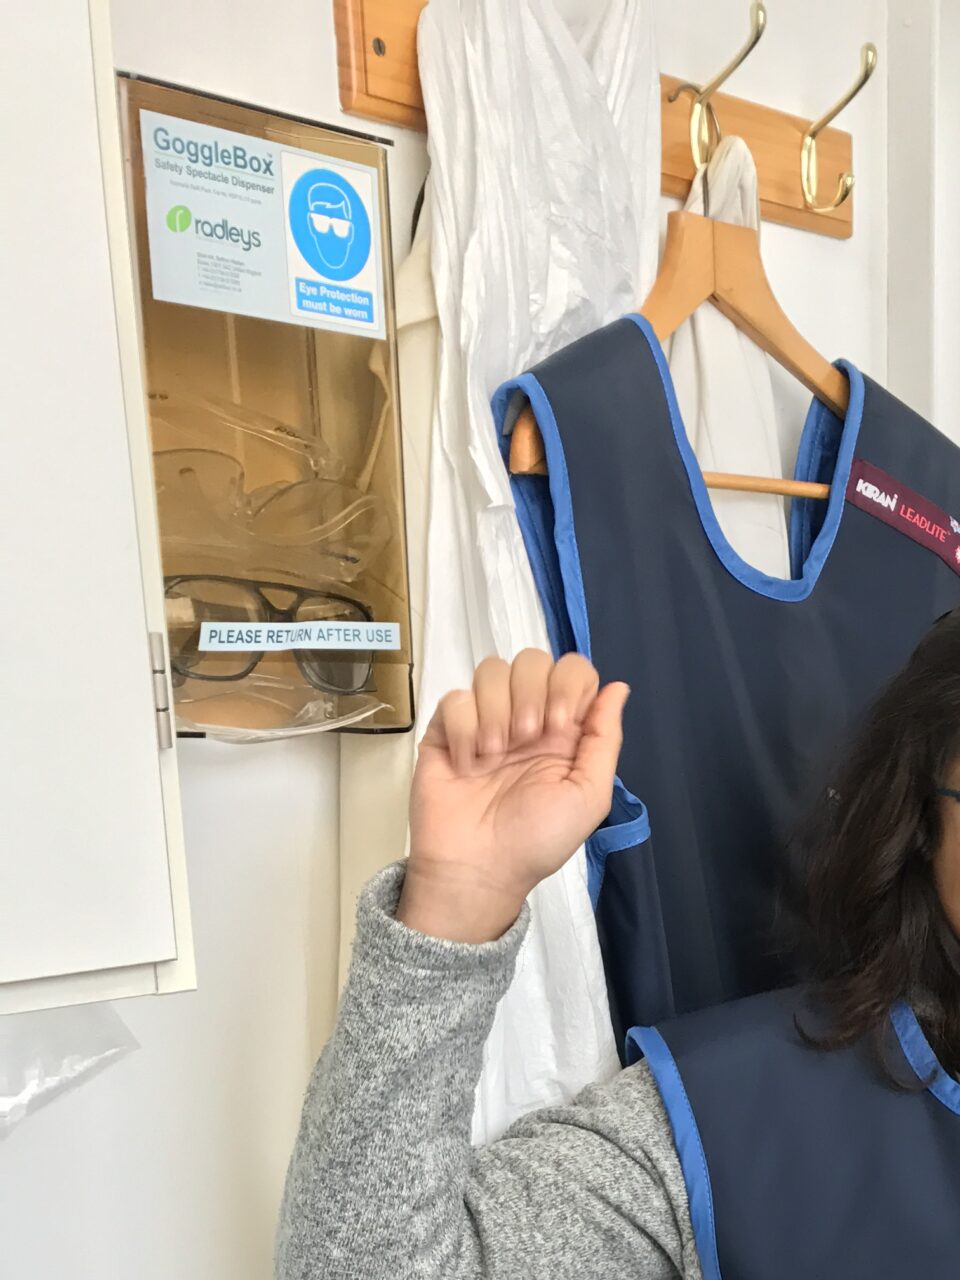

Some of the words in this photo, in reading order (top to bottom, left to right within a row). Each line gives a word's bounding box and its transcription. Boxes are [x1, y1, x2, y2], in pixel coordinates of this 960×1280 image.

[153, 127, 275, 177] GoggleBox
[154, 158, 184, 176] Safety
[186, 165, 230, 184] Spectacle
[231, 175, 275, 195] Dispenser
[194, 217, 262, 252] radleys
[299, 282, 317, 296] Eye
[319, 286, 369, 305] Protection
[302, 299, 327, 312] must
[329, 302, 342, 314] be
[343, 307, 368, 319] worn
[900, 504, 946, 543] LEADLITE
[208, 629, 262, 644] PLEASE
[266, 628, 312, 644] RETURN
[316, 628, 361, 643] AFTER
[367, 628, 393, 643] USE
